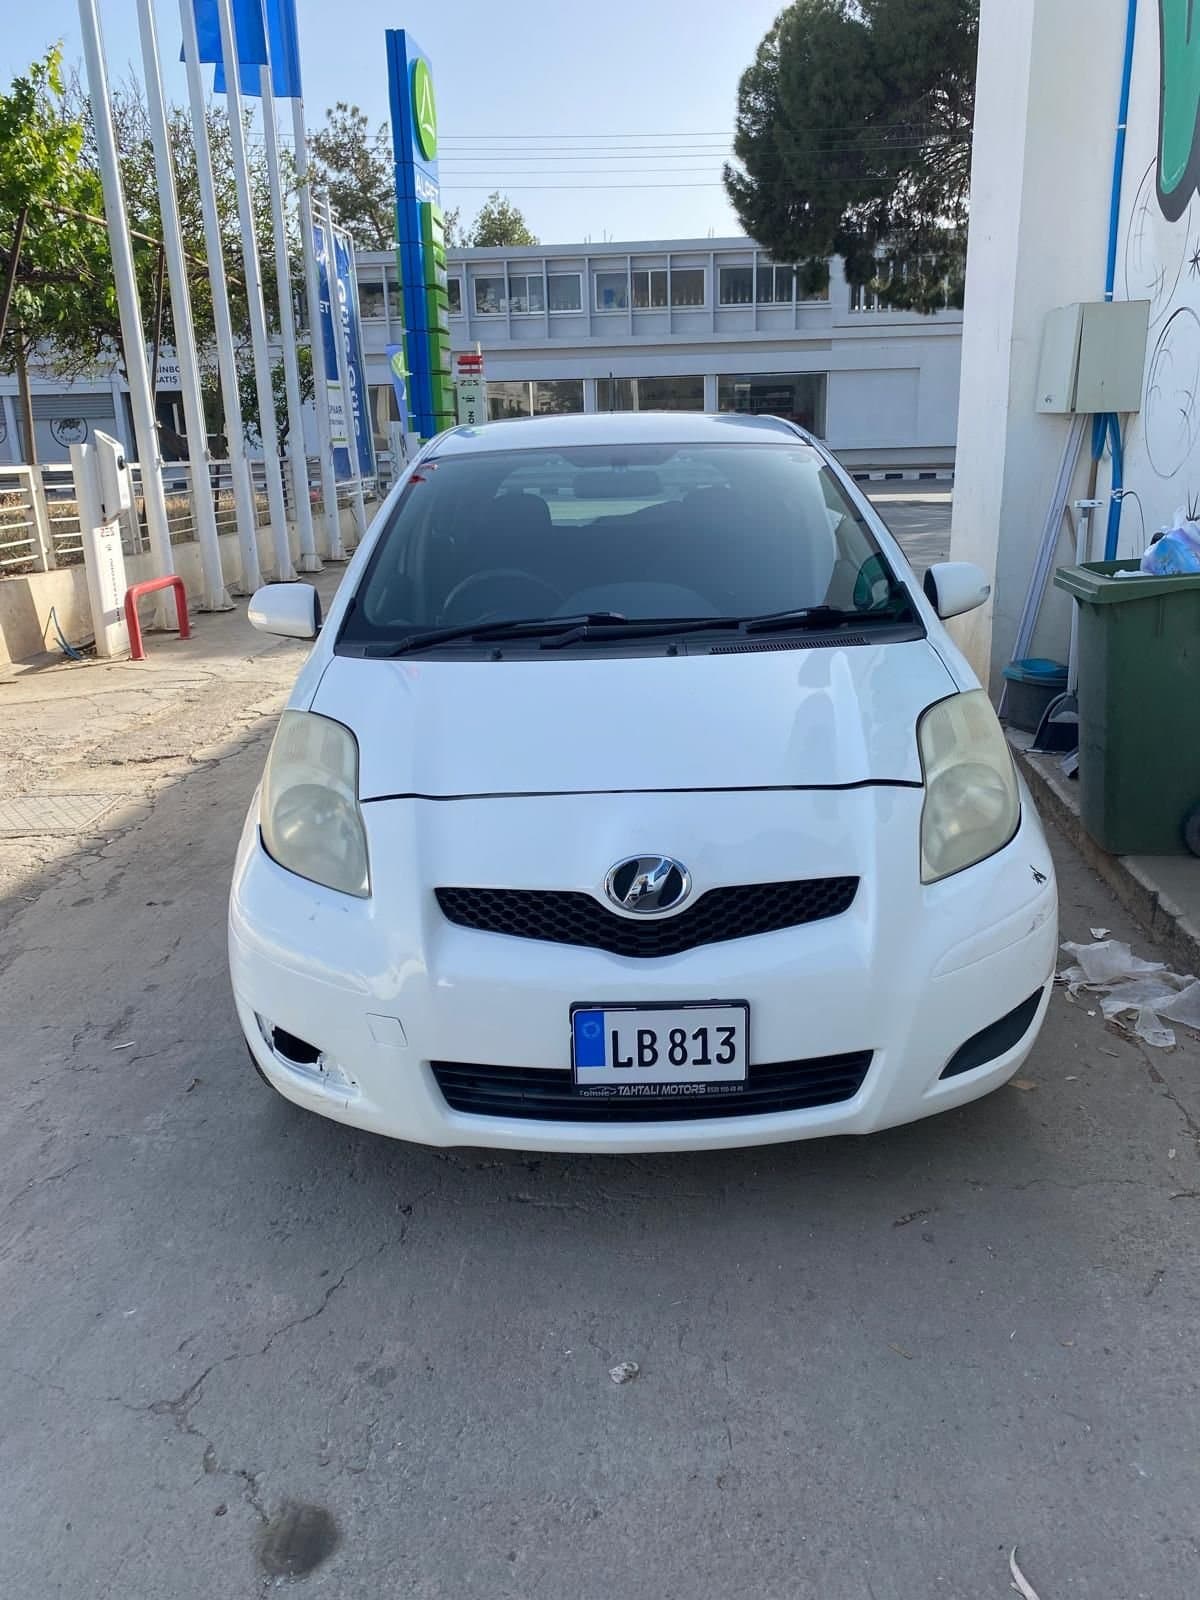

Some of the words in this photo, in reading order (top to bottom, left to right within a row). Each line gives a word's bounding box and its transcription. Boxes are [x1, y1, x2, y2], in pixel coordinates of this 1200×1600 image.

[612, 1029, 659, 1068] LB
[668, 1026, 736, 1067] 813
[618, 1085, 660, 1096] TAHTALI
[661, 1084, 706, 1095] MOTORS
